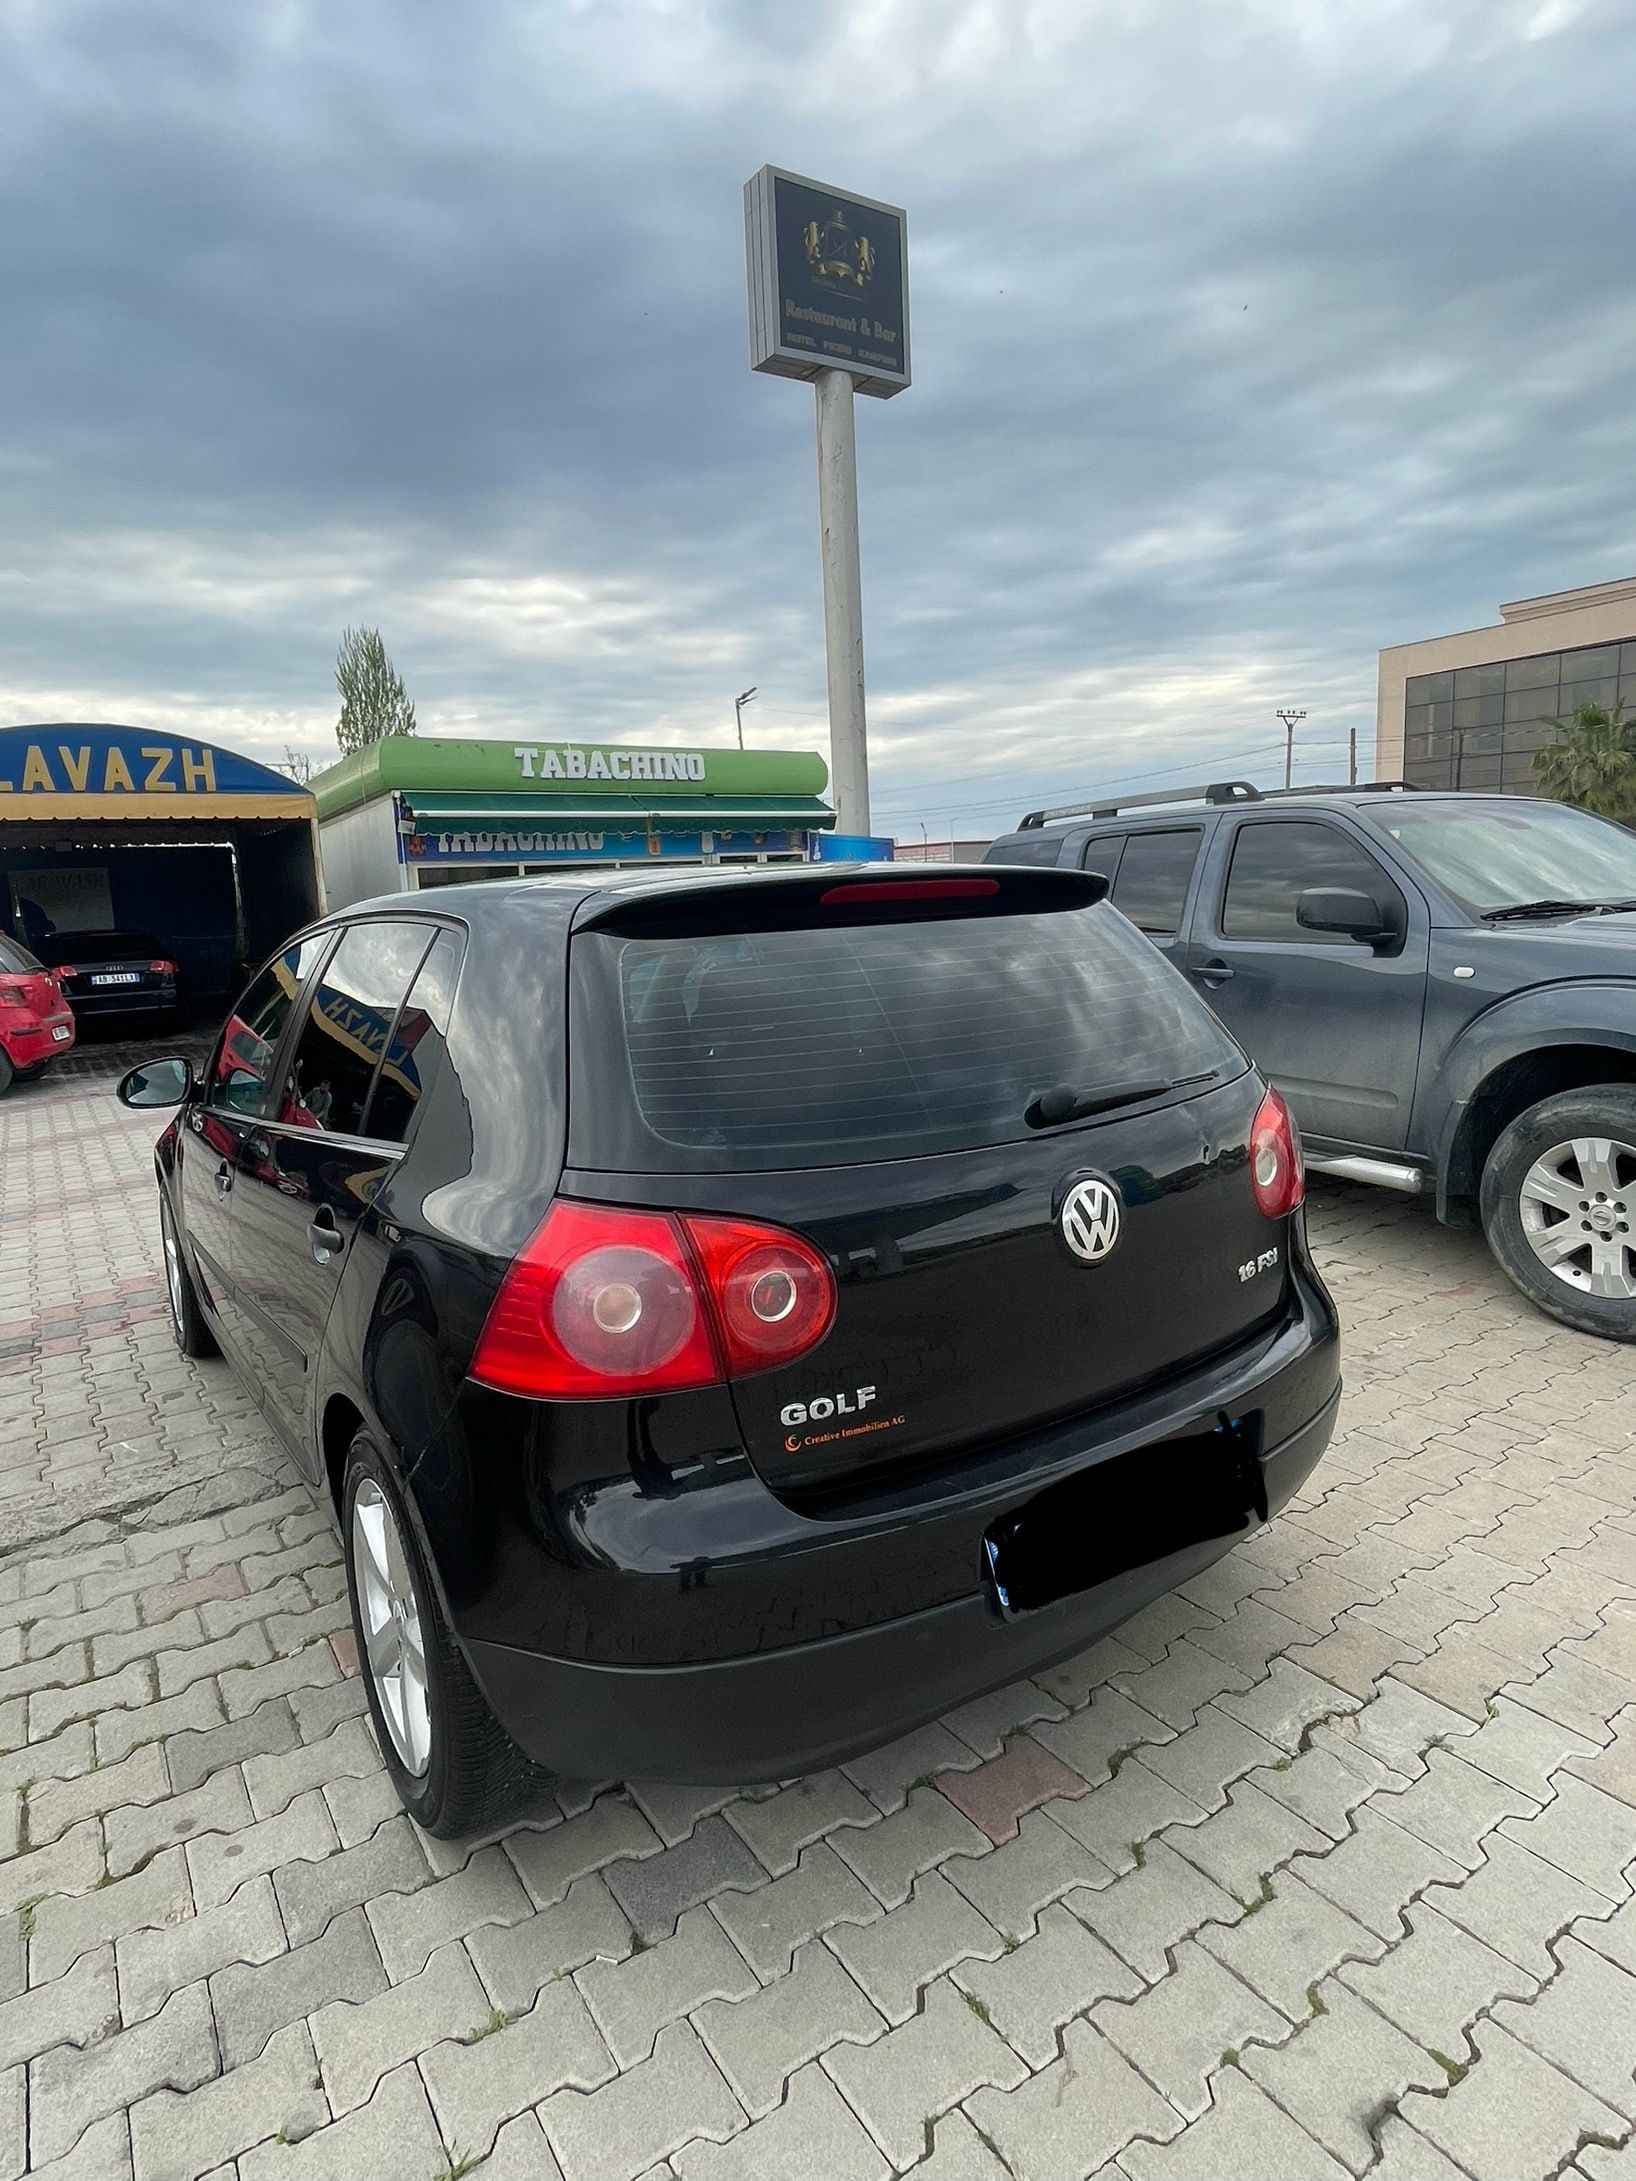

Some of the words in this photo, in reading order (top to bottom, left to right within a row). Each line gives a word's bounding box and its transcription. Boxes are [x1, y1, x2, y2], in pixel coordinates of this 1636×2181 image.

[874, 321, 897, 342] Bar
[0, 745, 217, 793] AVAZH
[514, 747, 706, 781] TABACHINO
[780, 1385, 876, 1426] GOLF
[804, 1431, 841, 1446] Creative
[841, 1420, 890, 1438] Immobilien
[890, 1414, 906, 1426] AG
